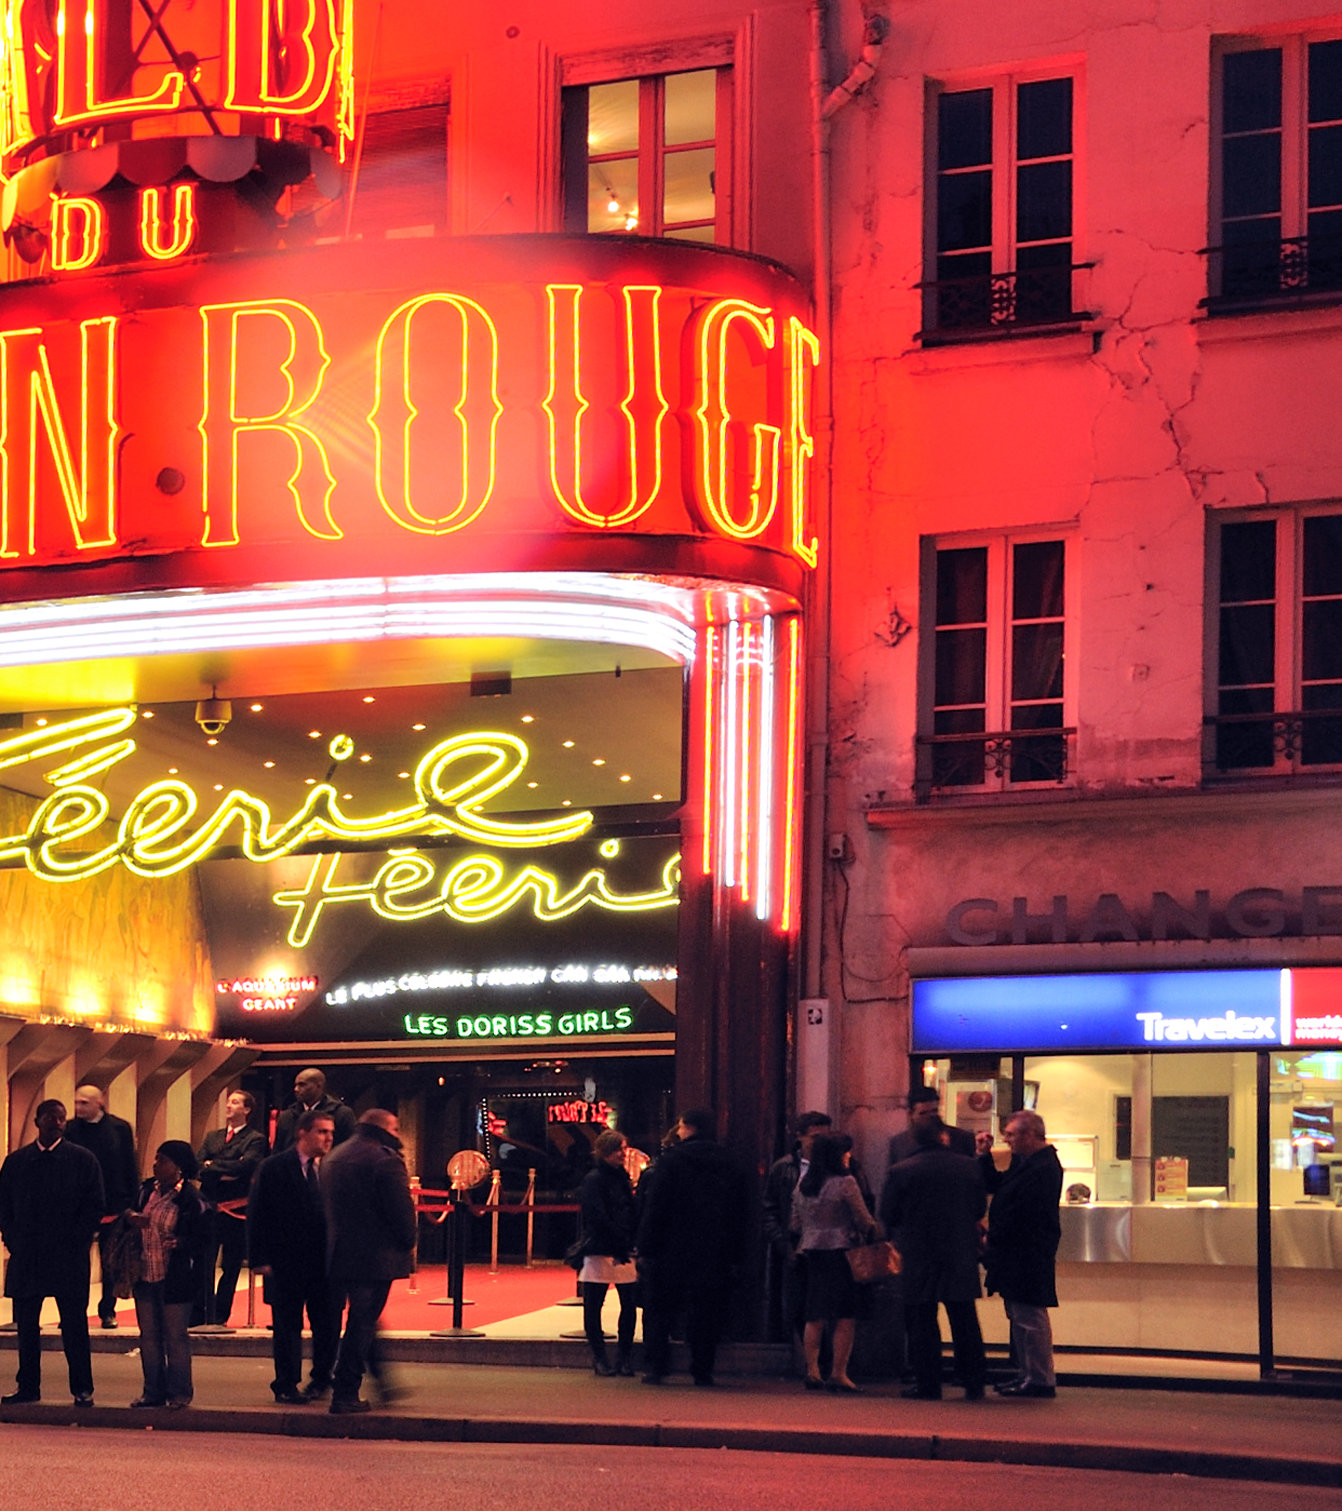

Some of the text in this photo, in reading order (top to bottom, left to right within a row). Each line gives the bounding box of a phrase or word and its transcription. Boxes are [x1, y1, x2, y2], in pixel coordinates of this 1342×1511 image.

[51, 184, 195, 271] DU
[197, 285, 819, 567] ROUGE
[944, 886, 1342, 945] CHANGE
[405, 1007, 633, 1037] LES DORISS GIRLS
[1136, 1010, 1276, 1041] Travelex
